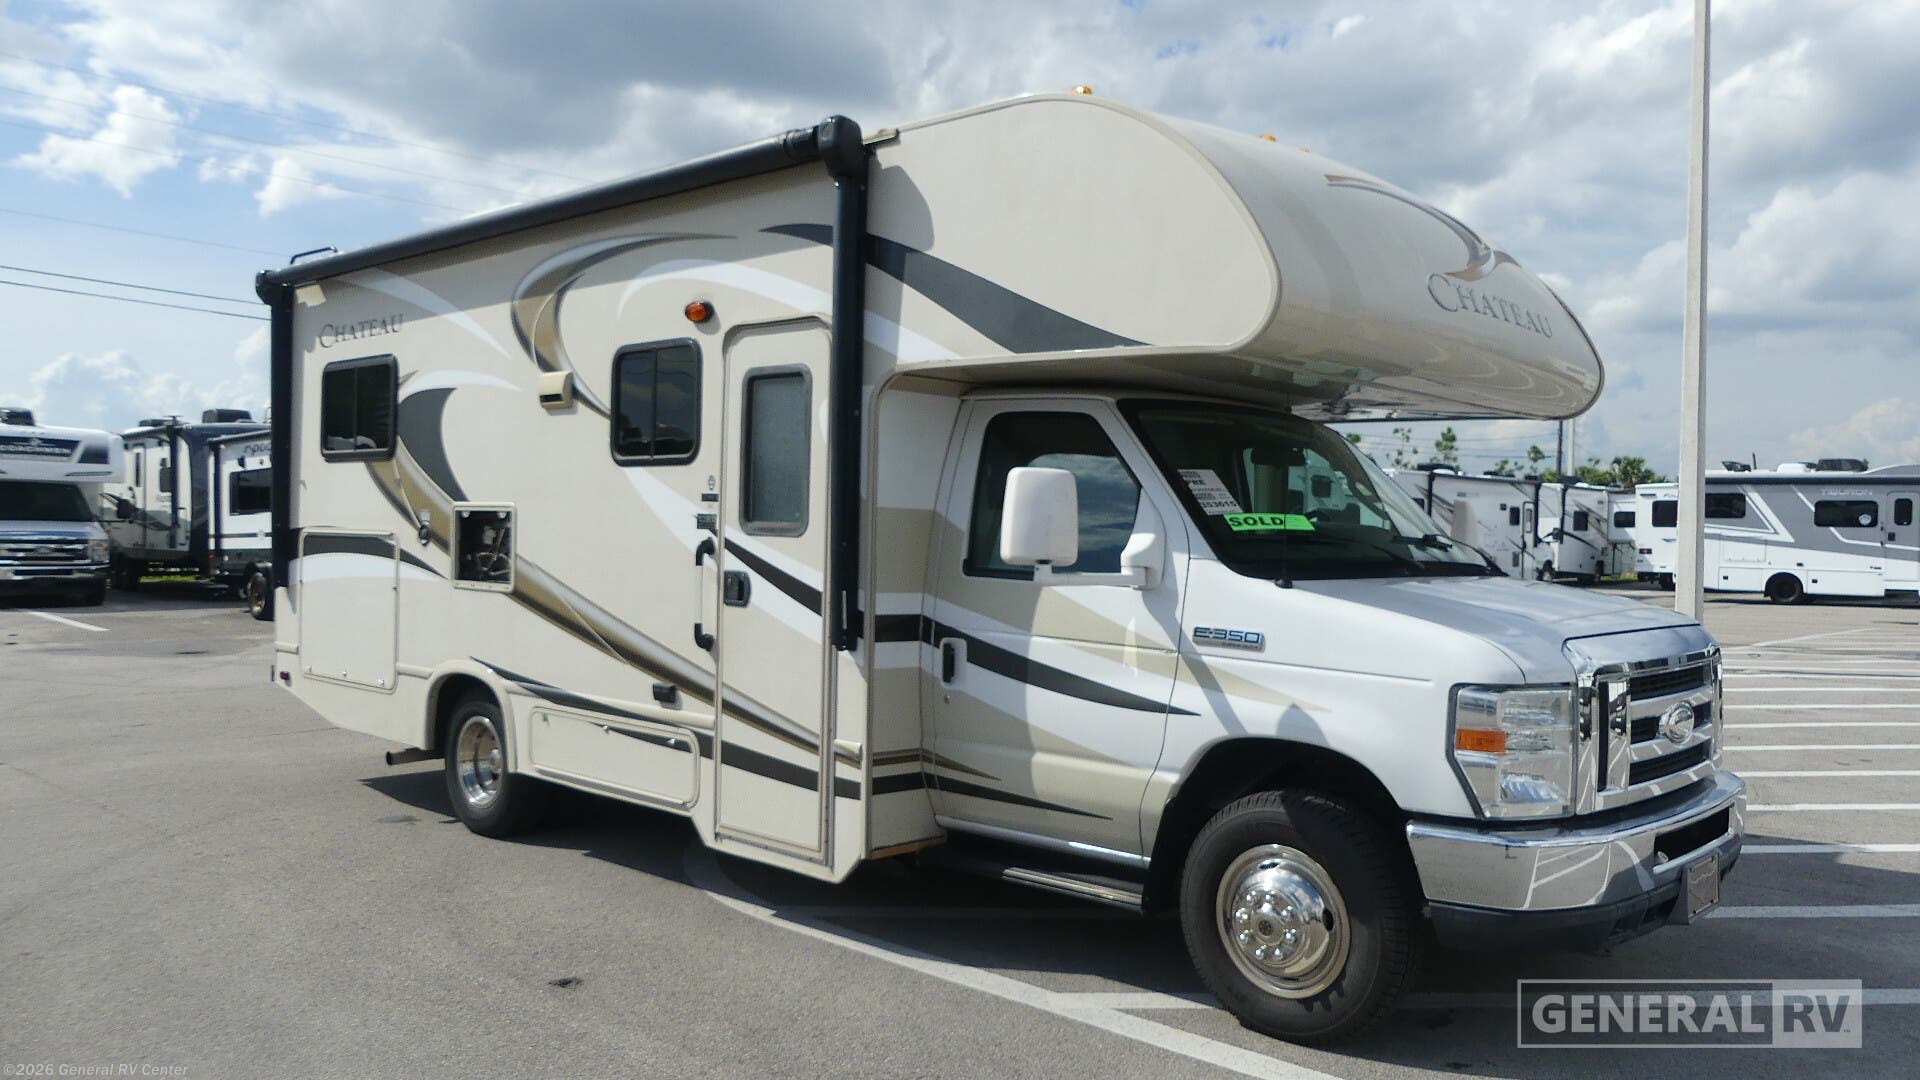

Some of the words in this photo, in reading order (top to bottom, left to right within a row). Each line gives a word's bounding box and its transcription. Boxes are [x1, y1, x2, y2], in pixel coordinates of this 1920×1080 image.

[1427, 272, 1553, 338] CHATEAU
[318, 313, 405, 348] CHATEAU
[1228, 516, 1284, 527] SOLD
